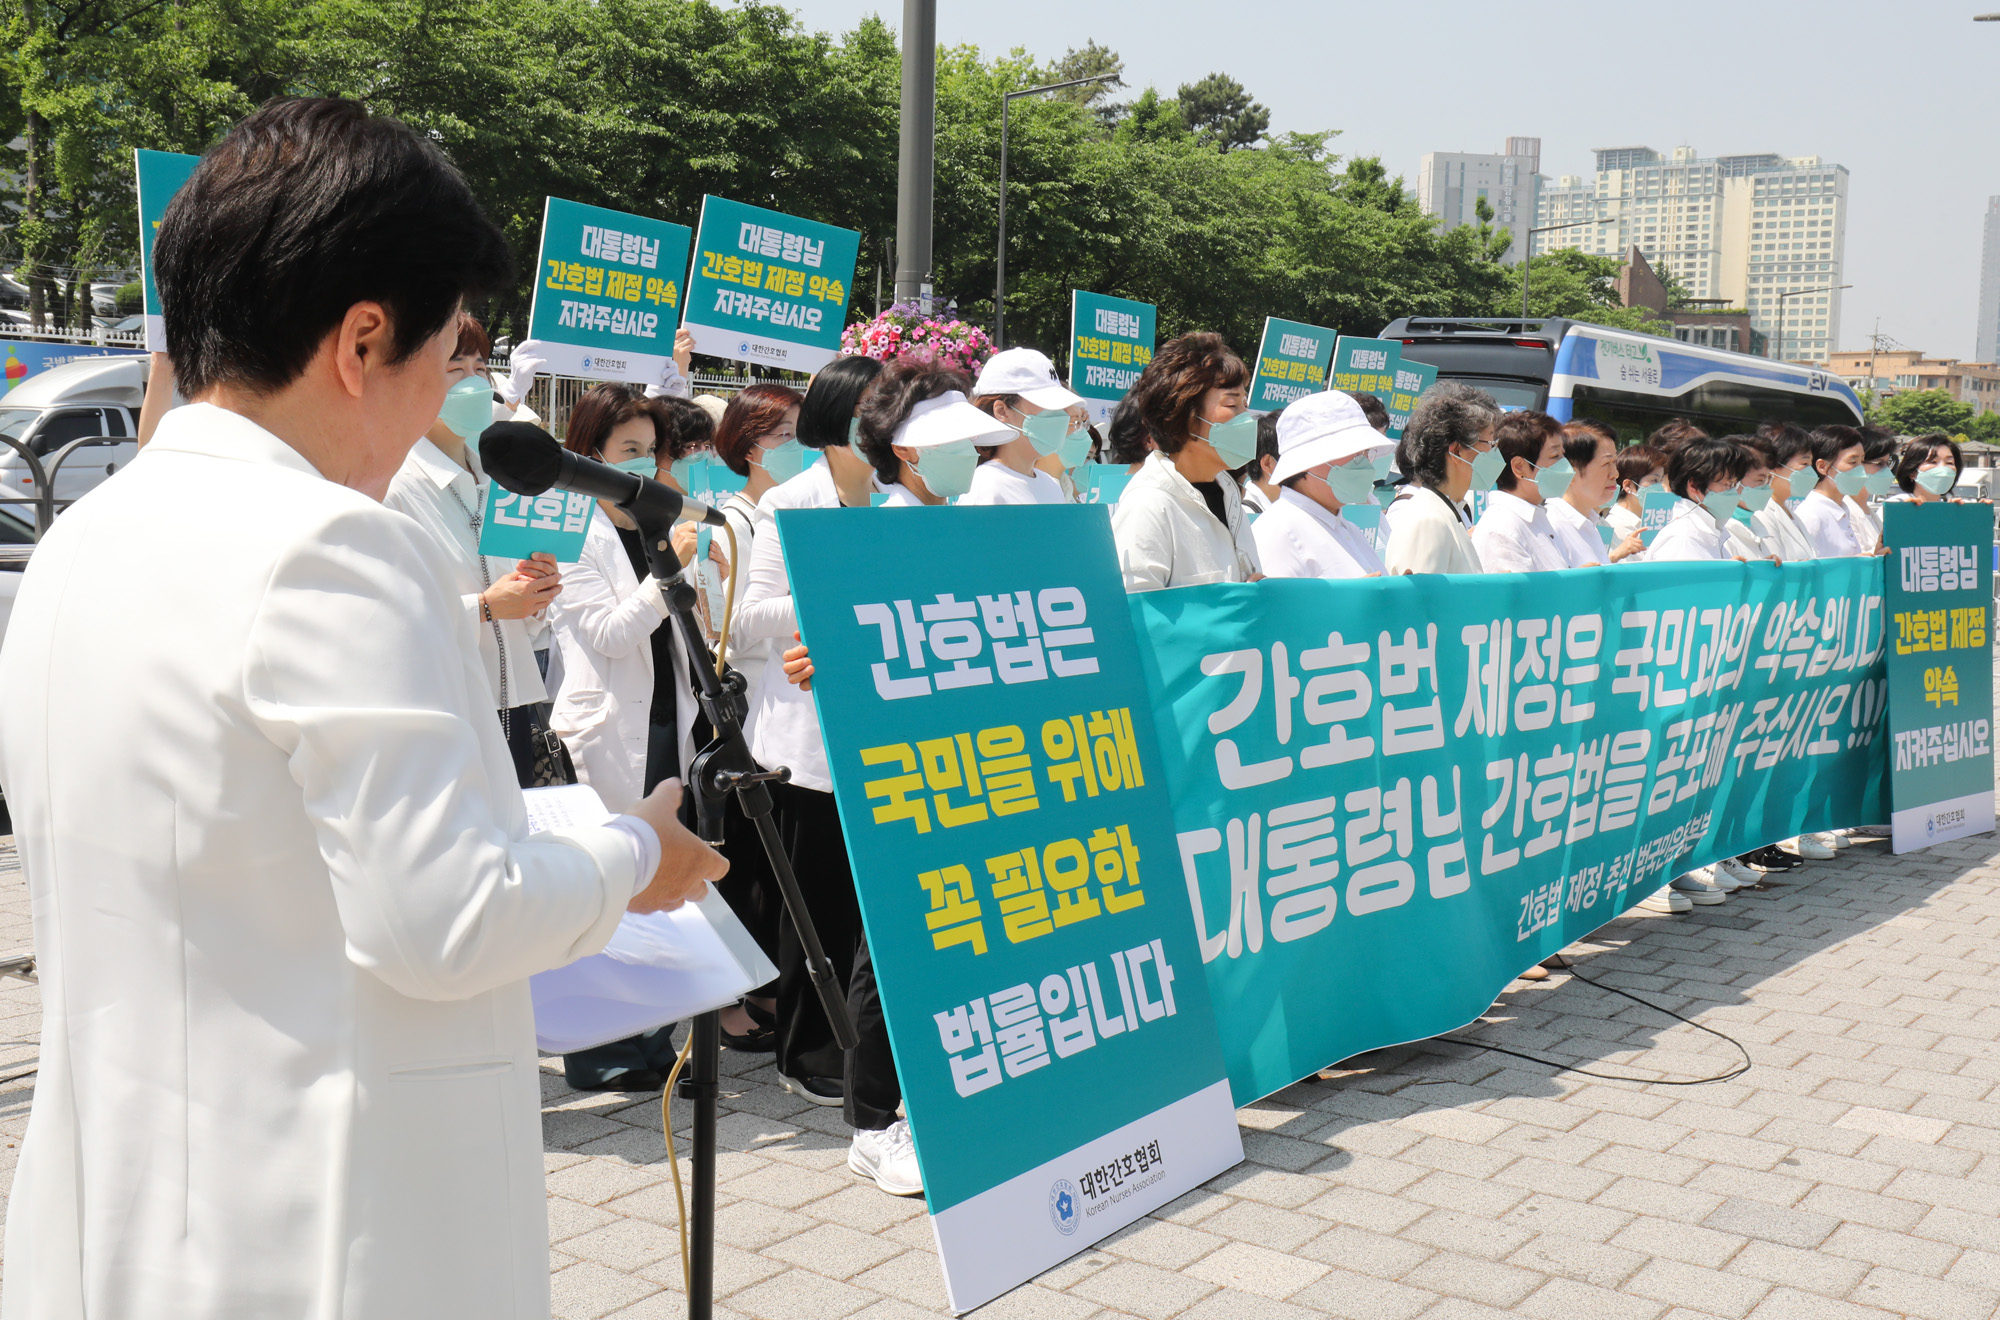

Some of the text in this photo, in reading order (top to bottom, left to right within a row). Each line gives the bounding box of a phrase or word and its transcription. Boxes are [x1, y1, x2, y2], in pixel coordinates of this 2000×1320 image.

[580, 225, 660, 269] 대통령님
[738, 222, 824, 268] 대통령님
[546, 259, 678, 308] 간호법 제정 약속
[702, 251, 845, 306] 간호법 제정 약속
[558, 300, 658, 338] 지켜주십시오
[714, 289, 823, 332] 지켜주십시오
[1095, 308, 1140, 339] 대통령님
[594, 357, 627, 369] 대한간호협회
[752, 344, 787, 358] 대한간호협회
[1077, 336, 1152, 366] 간호법 제정 약속
[1279, 333, 1319, 360] 대통령님
[1350, 349, 1388, 371] 대통령님
[1600, 339, 1646, 360] 전기버스 타고
[1259, 357, 1325, 385] 간호법 제정 약속
[1333, 373, 1393, 393] 간호법 제정 약속
[1395, 369, 1422, 392] 통령님
[1620, 364, 1659, 385] 숨 쉬는 서울로
[1900, 545, 1978, 593] 대통령님
[853, 586, 1100, 701] 간호법은
[1894, 606, 1986, 655] 간호법 제정
[1200, 622, 1445, 791] 간호법
[1454, 613, 1603, 738] 제정은
[1611, 602, 1763, 712] 국민과의
[1924, 665, 1958, 708] 약속
[1895, 718, 1990, 772] 지켜주십시오
[859, 707, 1145, 835] 국민을 위해
[1176, 764, 1470, 964] 대통령님
[1481, 728, 1651, 876] 간호법을
[1648, 701, 1744, 816] 공포해
[917, 824, 1146, 956] 꼭 필요한
[1517, 876, 1564, 943] 간호법
[1564, 862, 1604, 913] 제정
[1603, 848, 1635, 900] 추진
[932, 938, 1178, 1098] 법률입니다
[1079, 1139, 1163, 1200] 대한간호협회
[1085, 1170, 1167, 1218] Korean Nurses Association
